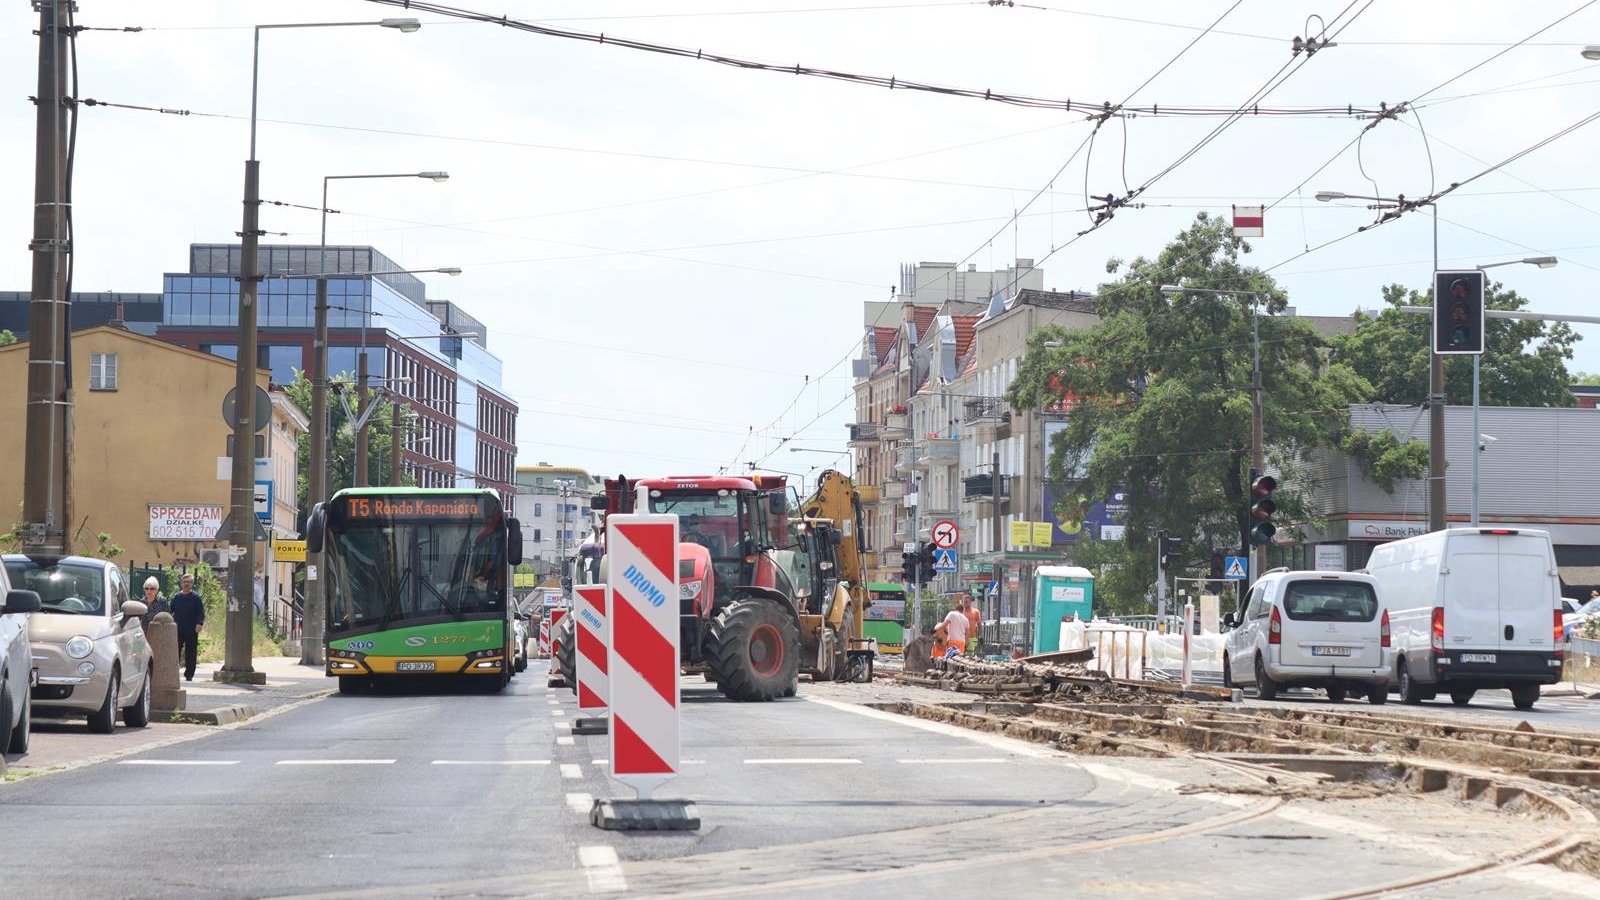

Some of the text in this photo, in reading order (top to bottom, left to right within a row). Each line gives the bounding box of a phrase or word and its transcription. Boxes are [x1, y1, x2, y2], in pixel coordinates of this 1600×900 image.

[151, 507, 220, 520] SPRZEDAM
[349, 498, 478, 517] T5 Rondo Kaponiera
[166, 519, 204, 527] DZIAŁKĘ
[152, 525, 173, 538] 602
[175, 525, 196, 538] 515
[1384, 526, 1407, 537] Bank
[623, 564, 666, 608] DROMO
[580, 608, 602, 630] DROMO
